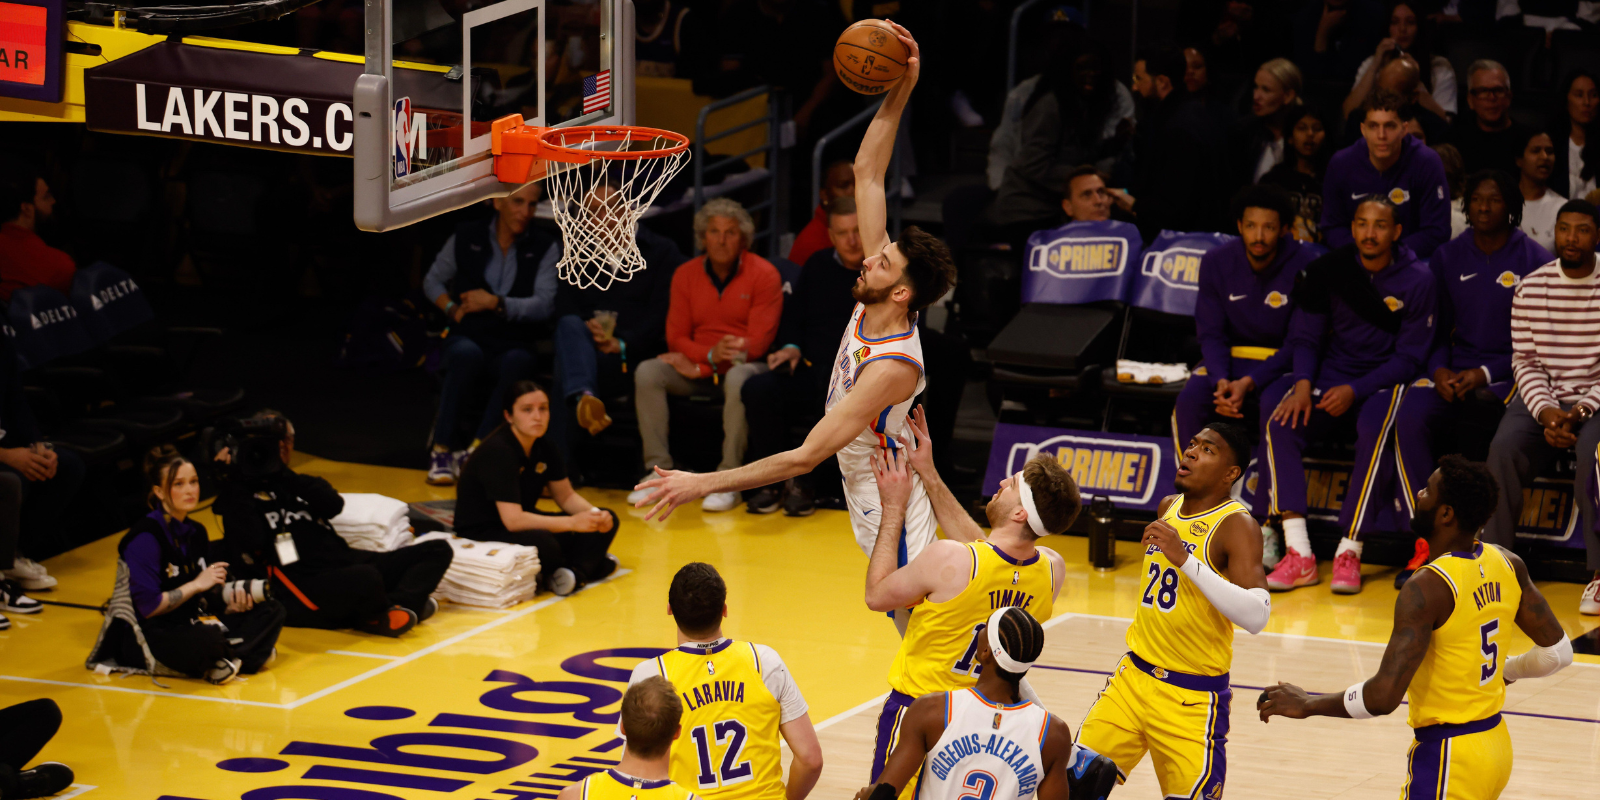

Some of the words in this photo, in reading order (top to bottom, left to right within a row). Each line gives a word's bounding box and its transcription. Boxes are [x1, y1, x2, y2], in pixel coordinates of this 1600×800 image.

[136, 83, 427, 160] LAKERS.CM
[397, 160, 406, 175] NBA
[1171, 255, 1202, 283] PRI
[99, 278, 139, 304] DELTA
[39, 305, 78, 325] DELTA
[988, 589, 1034, 609] TIMME
[1141, 561, 1179, 613] 28
[1472, 581, 1501, 611] AYTON
[709, 640, 719, 648] PRO
[1479, 617, 1500, 687] 5
[682, 680, 745, 711] LARAVIA
[1348, 690, 1357, 702] 5
[690, 718, 754, 789] 12
[931, 733, 1038, 797] GILGEOUS-ALEXANDER
[957, 769, 998, 800] 2
